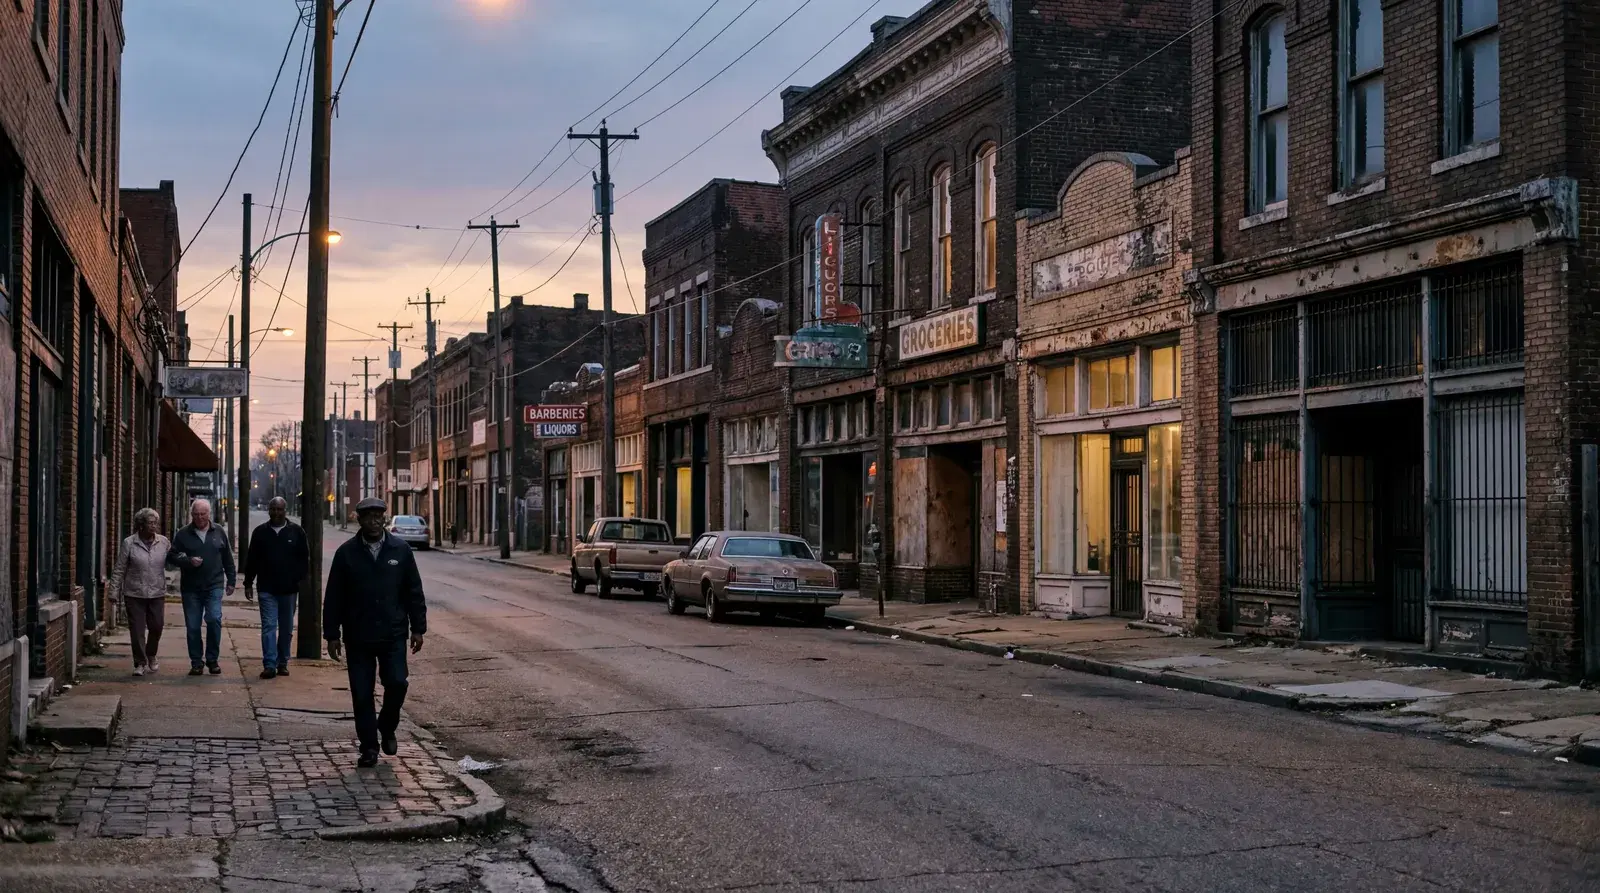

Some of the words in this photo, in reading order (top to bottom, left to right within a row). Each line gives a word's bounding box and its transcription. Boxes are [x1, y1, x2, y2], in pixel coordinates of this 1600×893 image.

[901, 311, 974, 354] GROCERIES
[529, 408, 585, 419] BARBERIES
[544, 424, 577, 436] LIQUORS
